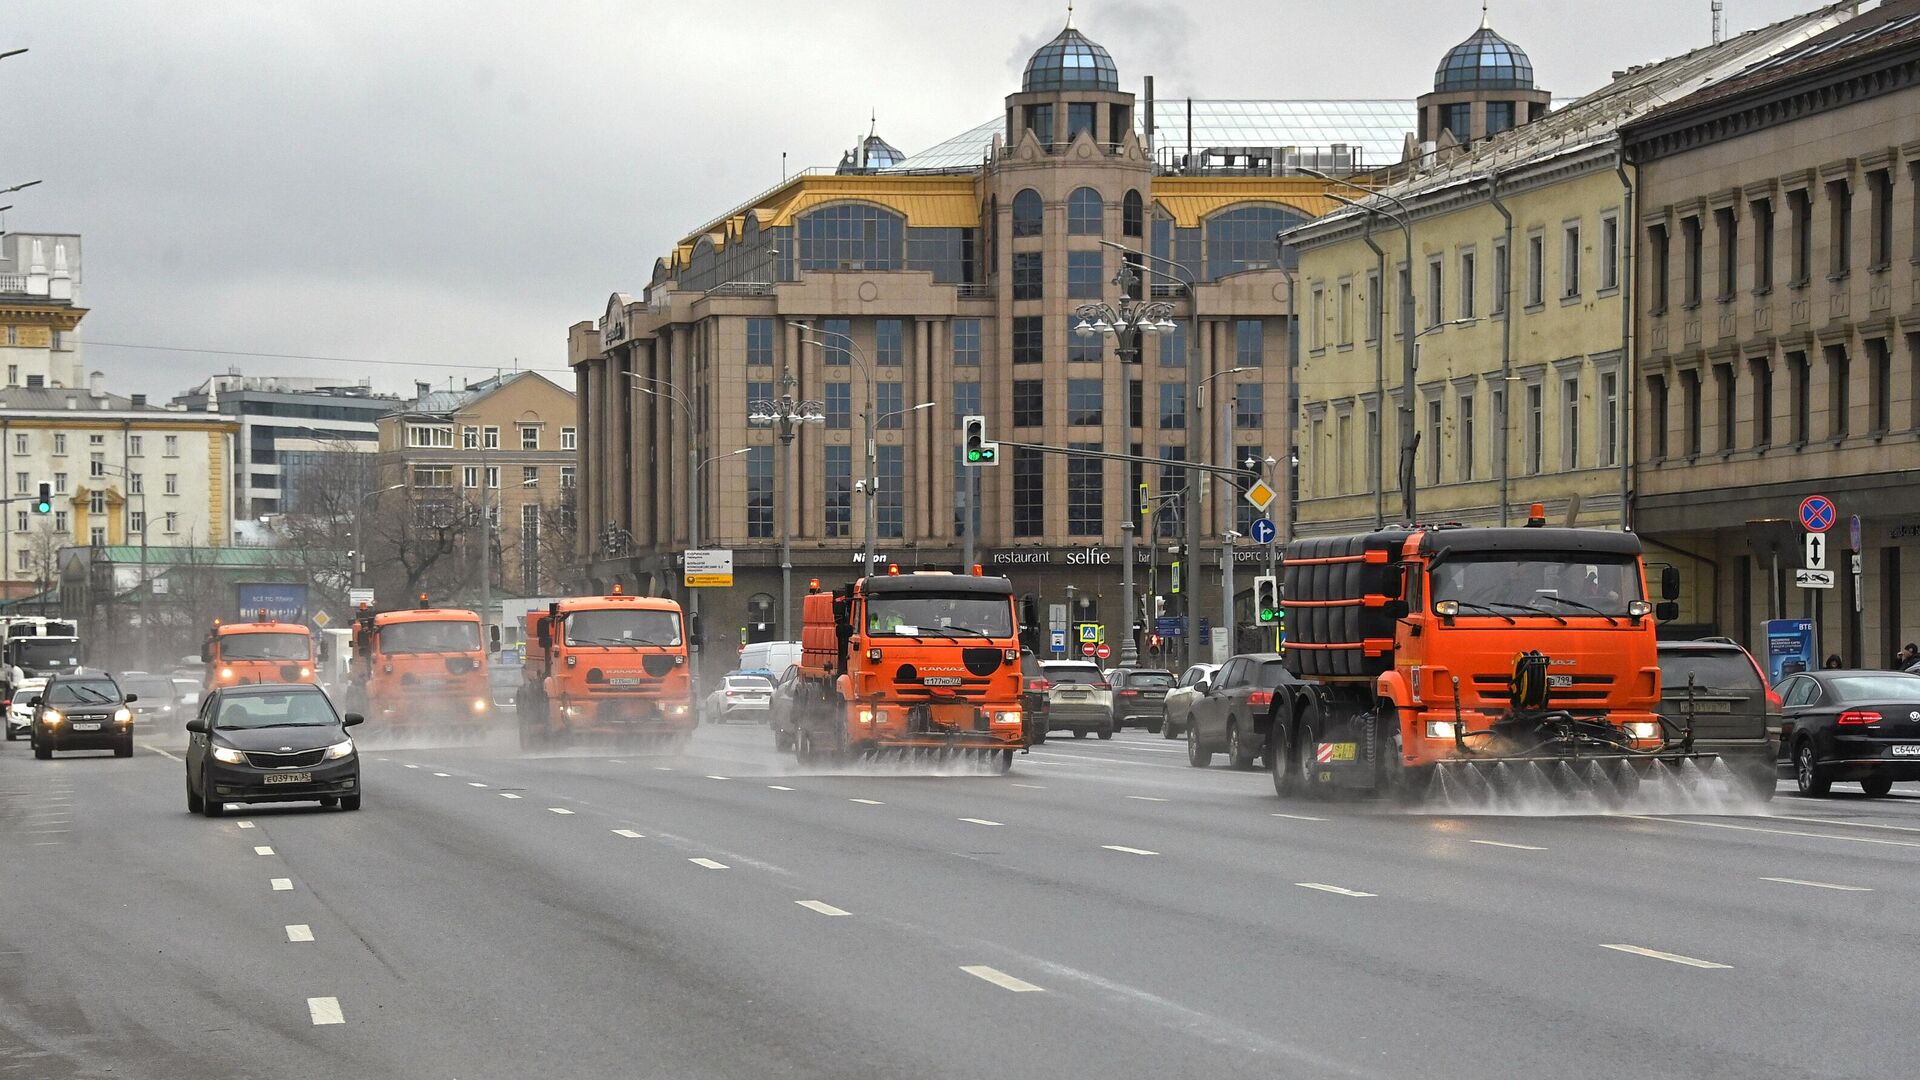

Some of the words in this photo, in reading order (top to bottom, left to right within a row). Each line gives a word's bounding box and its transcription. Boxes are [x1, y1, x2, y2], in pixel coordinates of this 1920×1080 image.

[852, 552, 887, 563] Nion
[993, 551, 1050, 563] restaurant
[1066, 547, 1111, 565] selfie
[1138, 551, 1150, 563] bar
